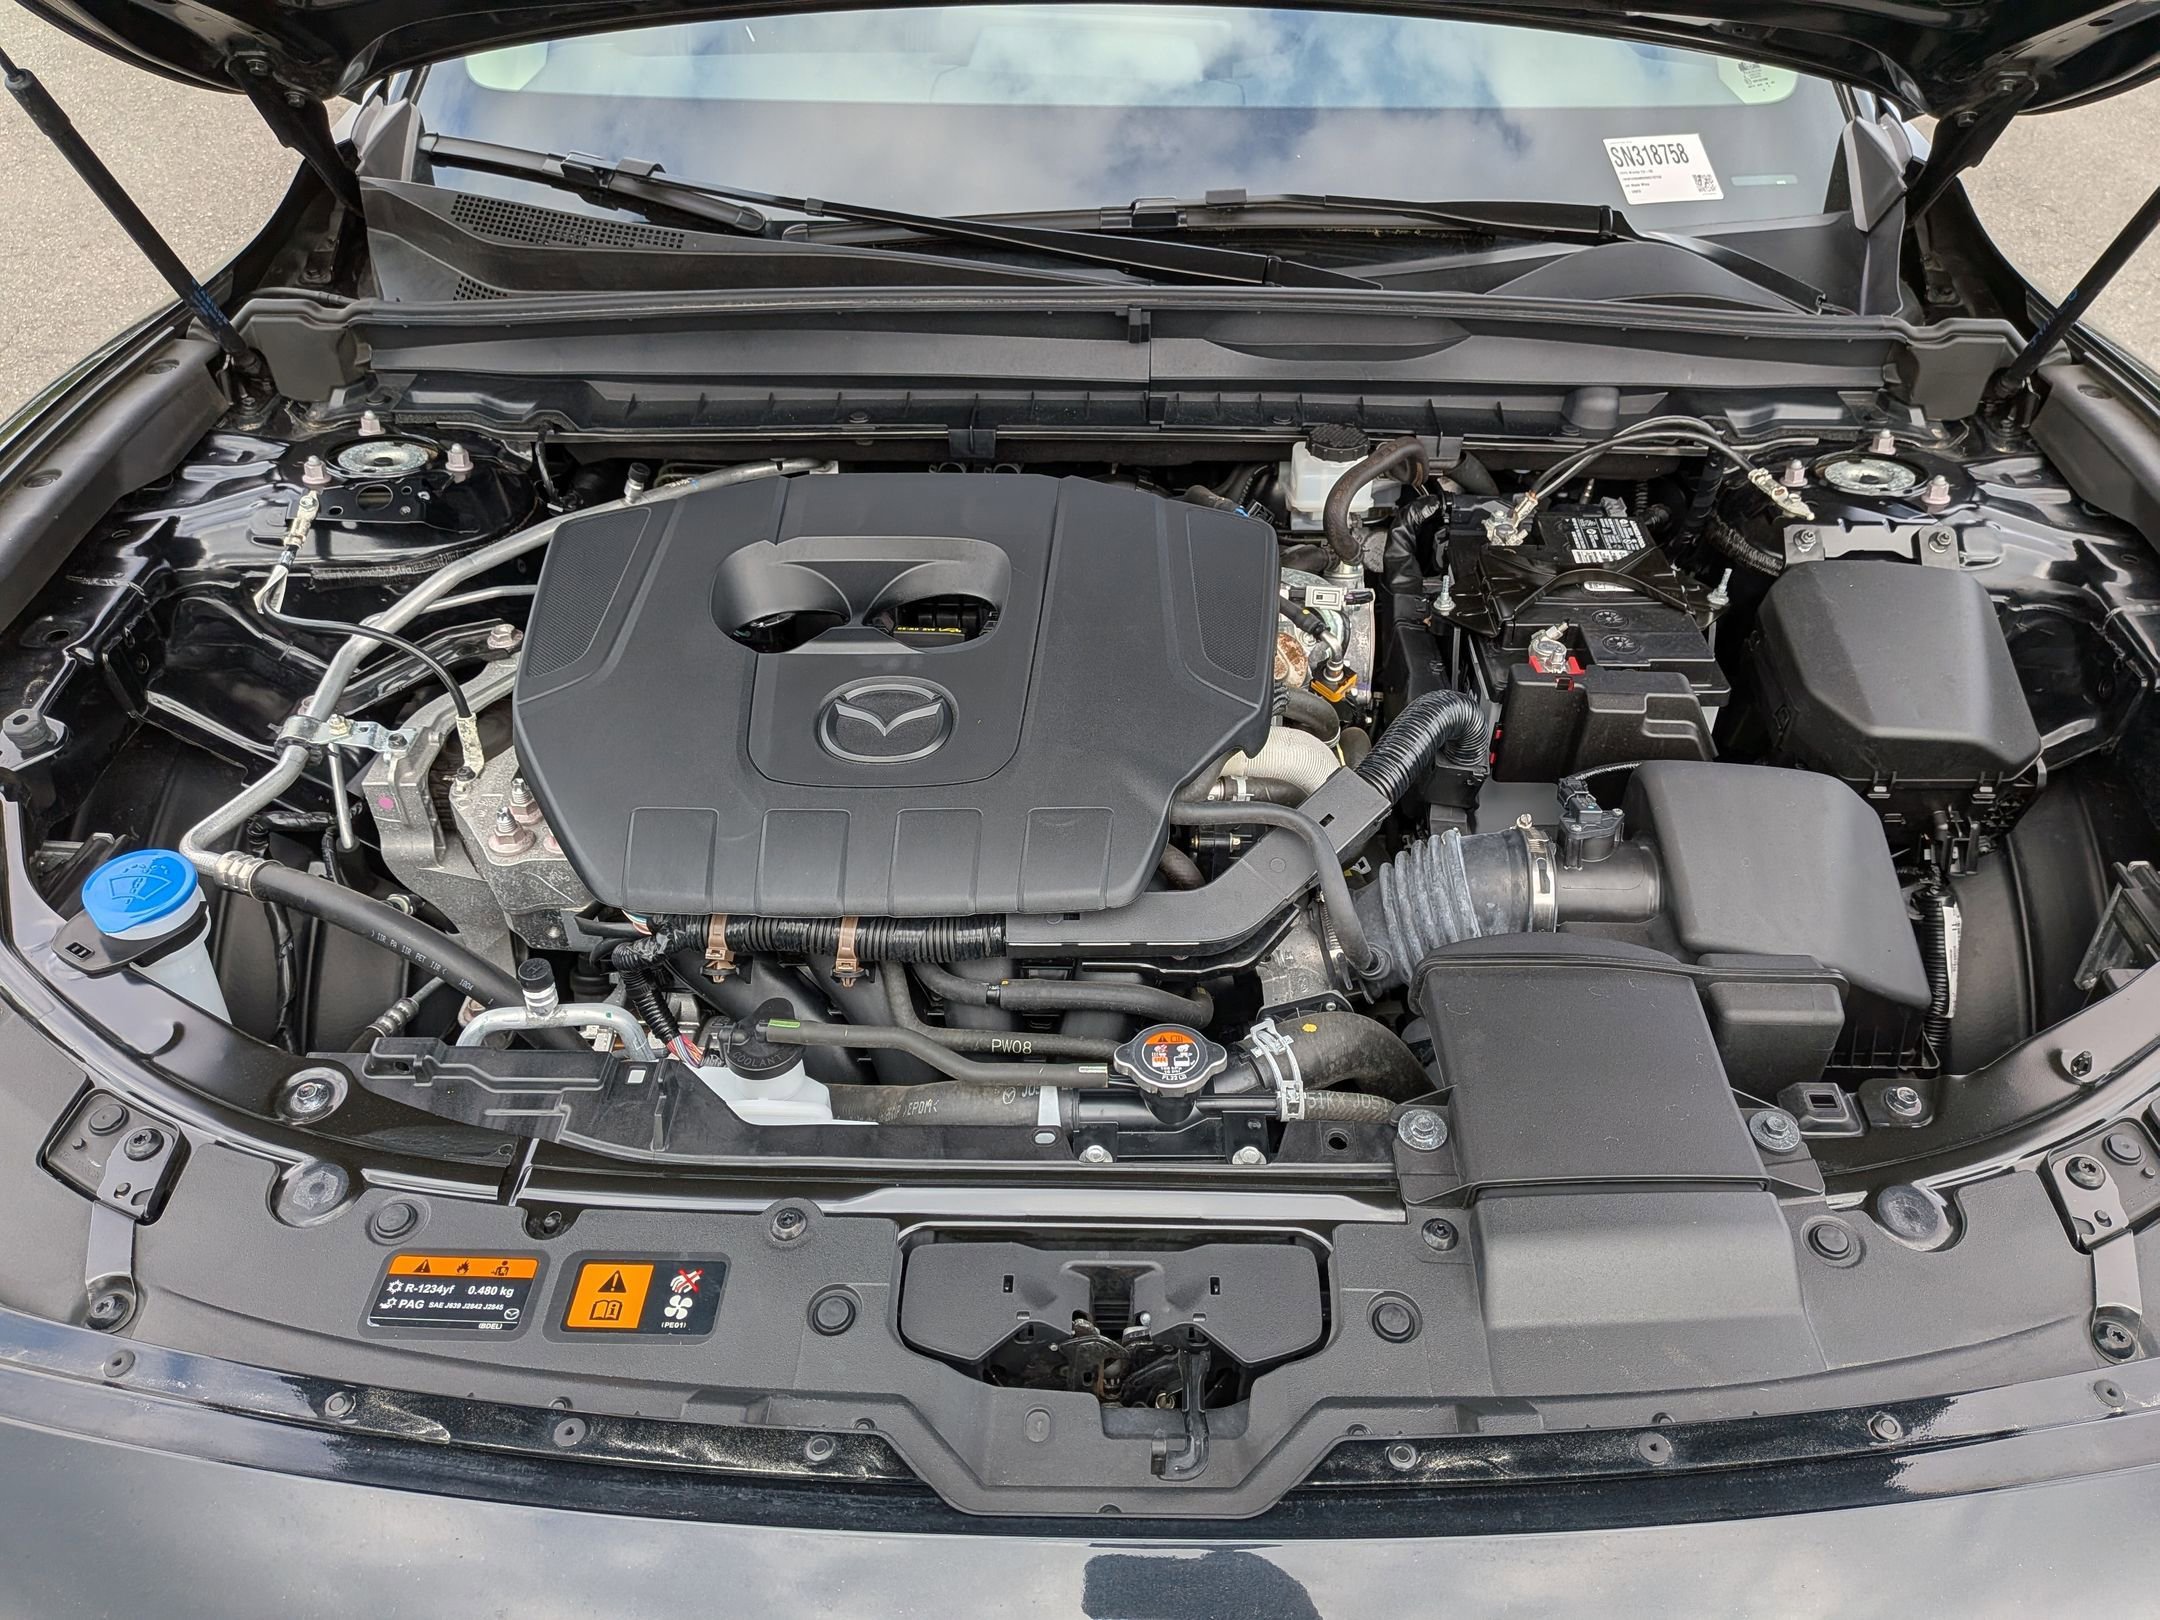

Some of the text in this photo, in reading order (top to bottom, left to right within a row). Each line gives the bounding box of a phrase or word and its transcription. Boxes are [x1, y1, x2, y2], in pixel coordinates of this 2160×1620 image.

[1610, 142, 1690, 168] SN318758
[991, 1038, 1032, 1054] PW08
[731, 1051, 784, 1067] COOLANT
[404, 1283, 515, 1298] R-1234yf 0.480 kg
[397, 1298, 425, 1309] PAG
